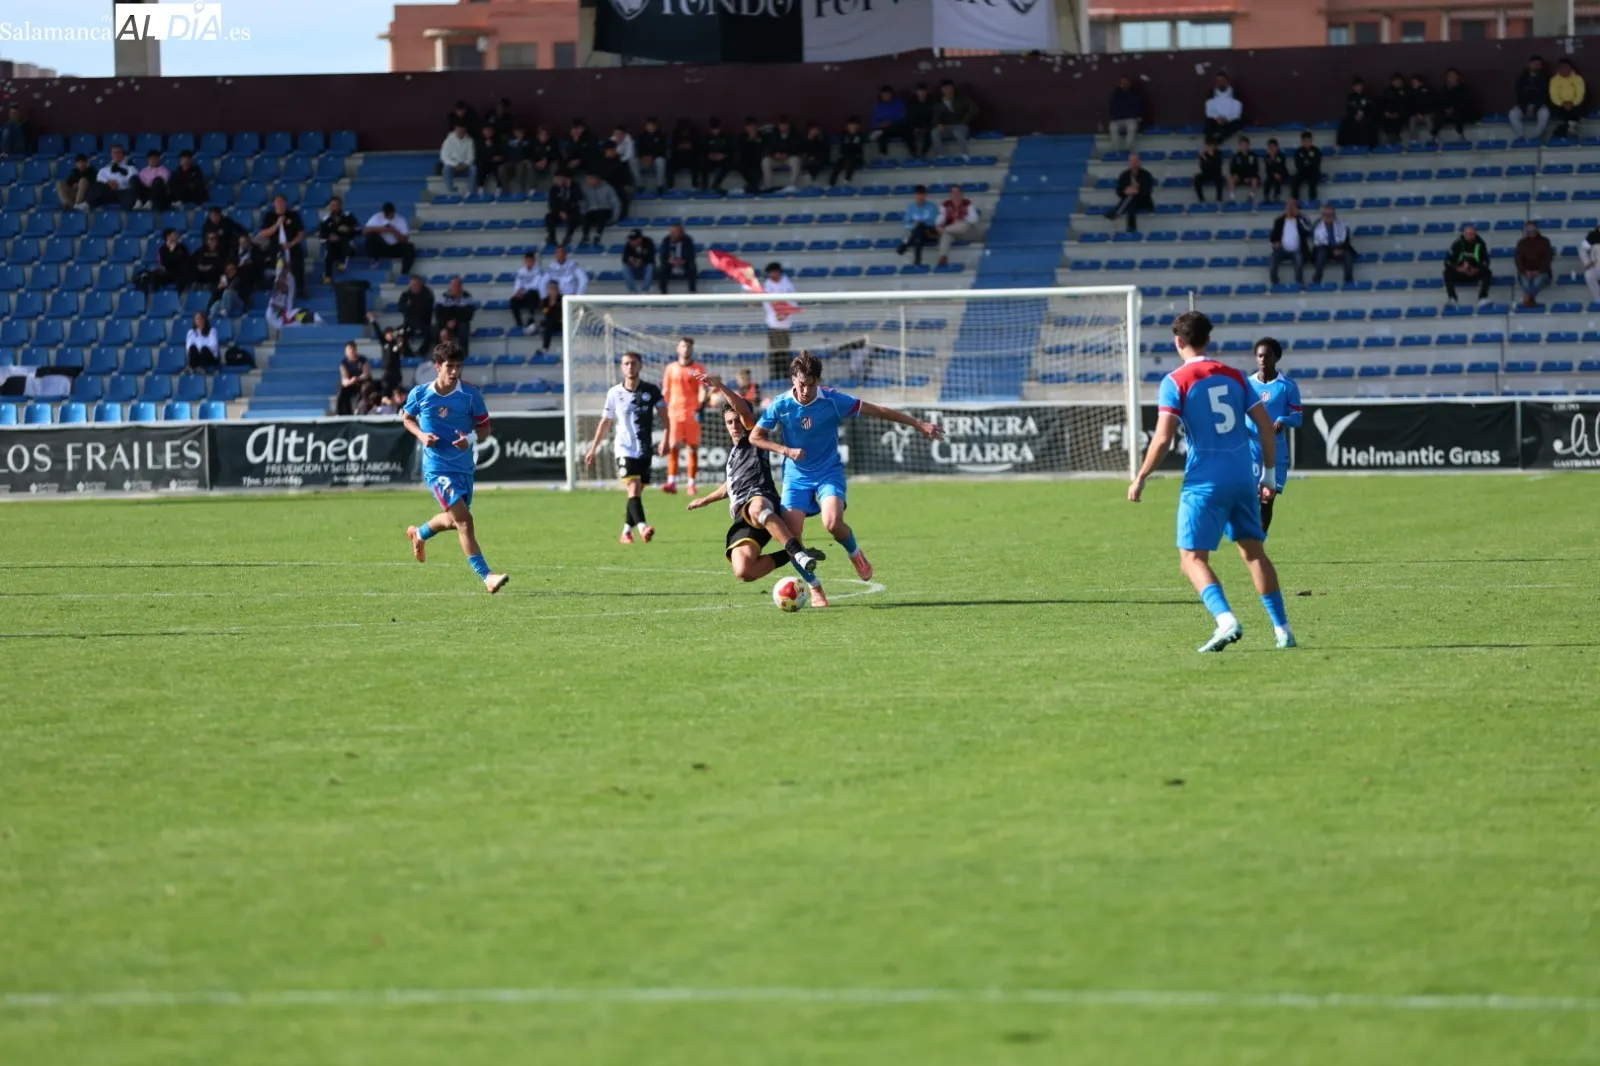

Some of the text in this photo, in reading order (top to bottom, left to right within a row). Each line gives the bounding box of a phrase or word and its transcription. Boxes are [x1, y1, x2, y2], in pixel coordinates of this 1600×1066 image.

[1207, 384, 1236, 434] 5
[924, 411, 1039, 437] TERNERA
[66, 439, 201, 472] FRAILES
[931, 440, 1035, 464] CHARRA
[1341, 445, 1500, 466] Helmantic Grass
